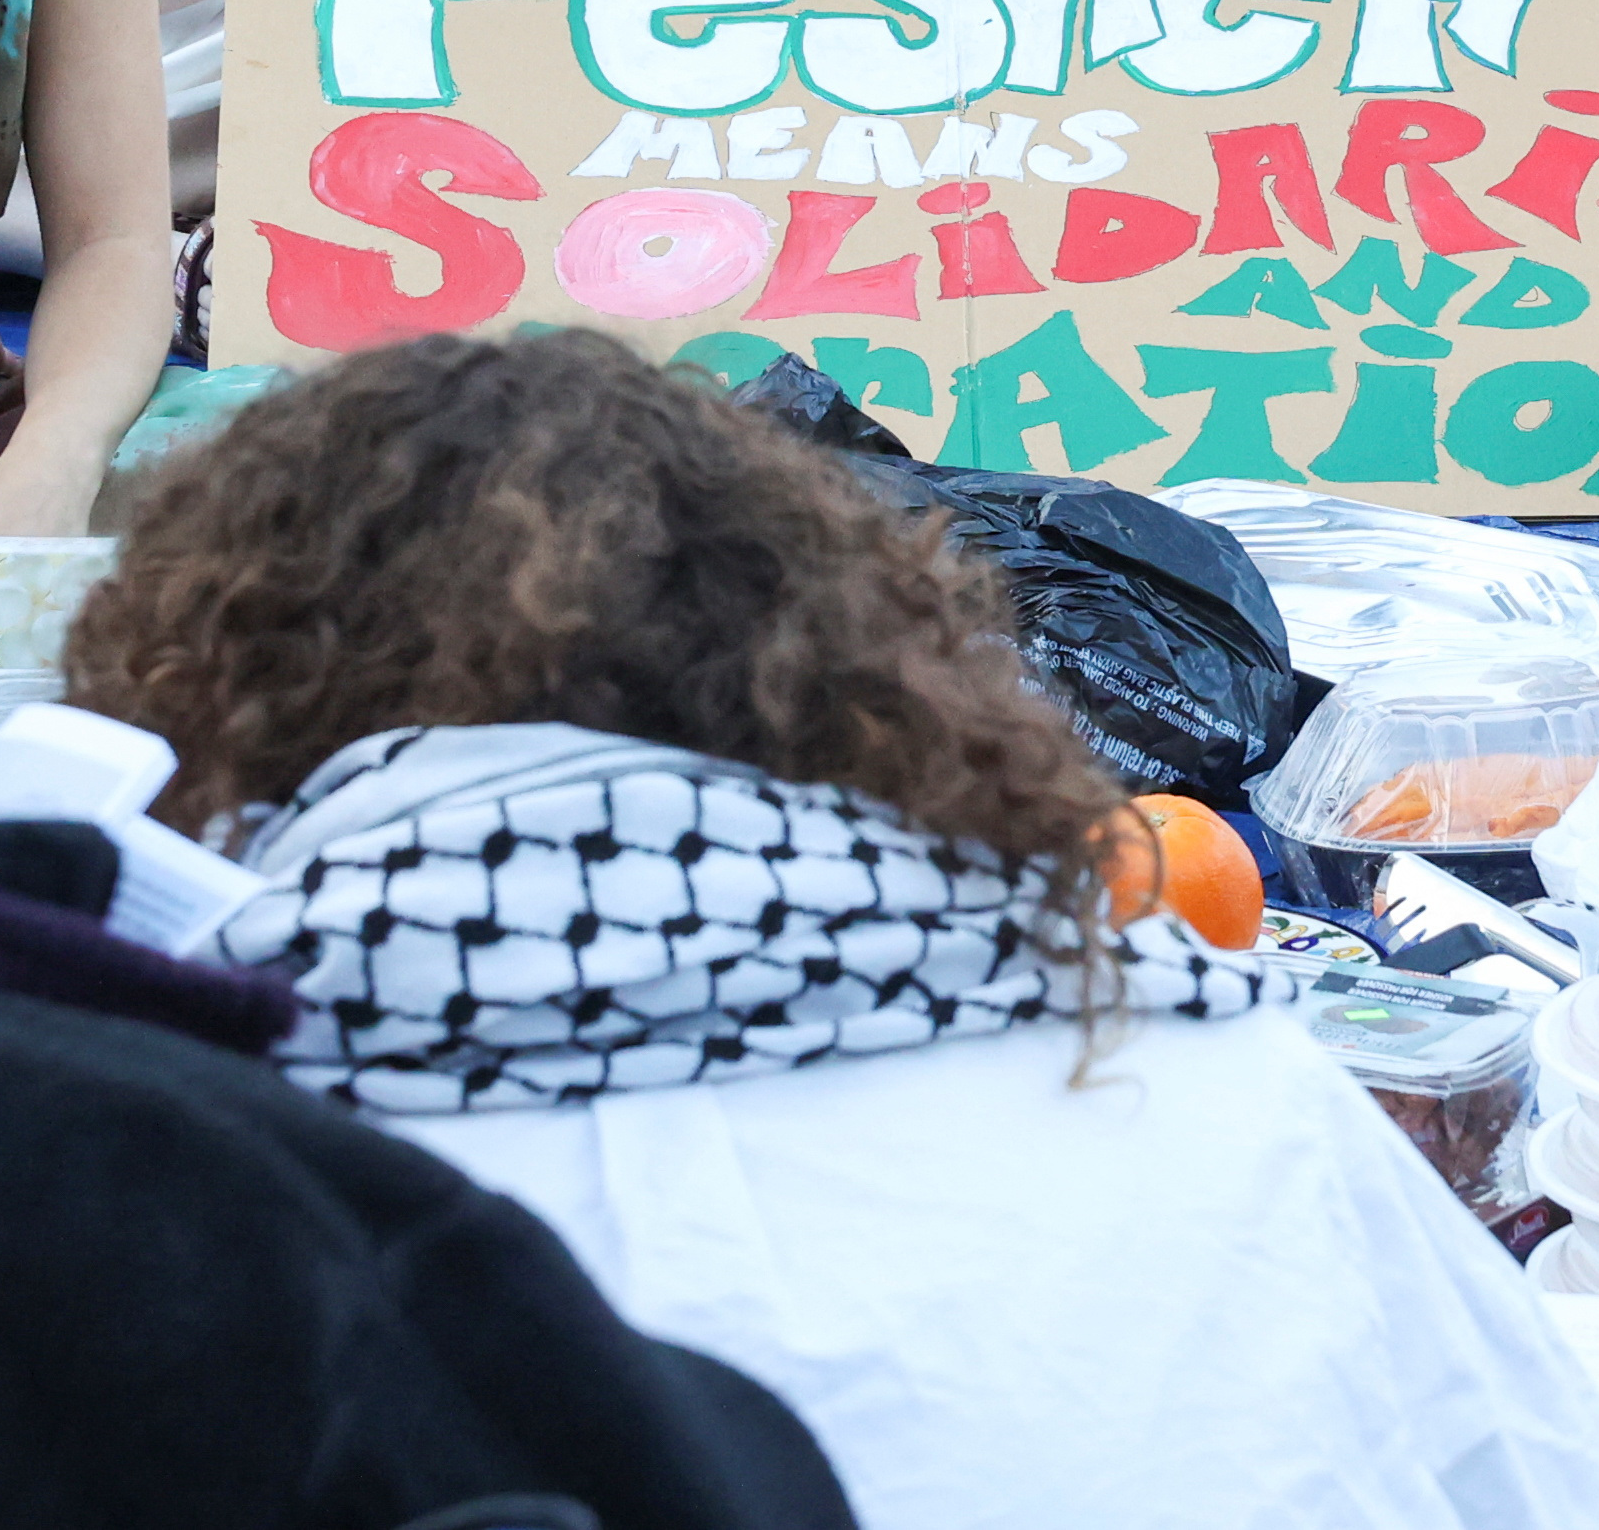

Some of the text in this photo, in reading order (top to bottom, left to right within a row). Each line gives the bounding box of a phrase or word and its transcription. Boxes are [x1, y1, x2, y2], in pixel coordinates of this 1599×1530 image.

[567, 106, 1140, 188] MEANS
[1172, 235, 1590, 329] AND
[1091, 653, 1122, 678] AWAY
[1121, 667, 1148, 689] BAG
[1103, 677, 1135, 701] AVOID
[1134, 693, 1150, 711] TO
[1147, 680, 1195, 714] PLASTIC
[1157, 706, 1208, 742] WARNING
[1214, 718, 1242, 743] KEEP
[1102, 734, 1146, 771] return
